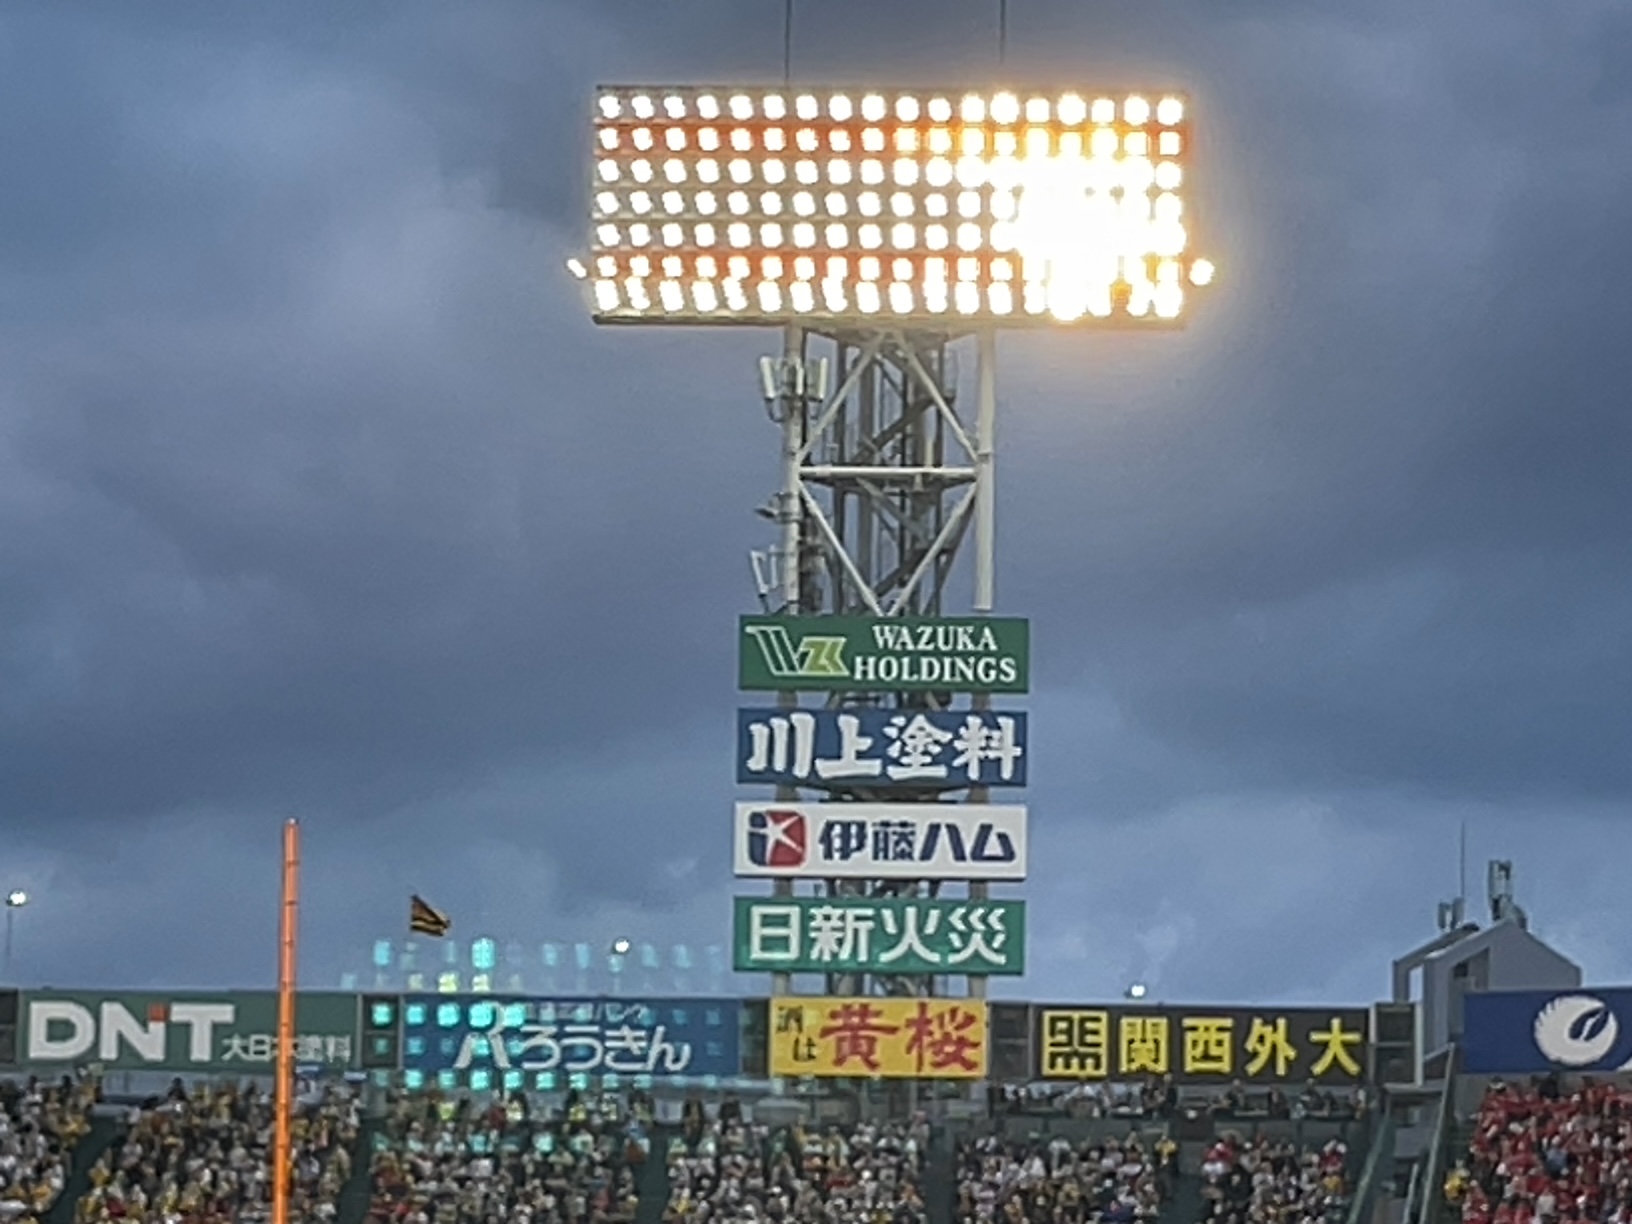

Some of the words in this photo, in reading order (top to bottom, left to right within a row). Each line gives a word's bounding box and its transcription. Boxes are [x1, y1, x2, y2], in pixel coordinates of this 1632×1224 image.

[872, 625, 998, 651] WAZUKA
[854, 655, 1017, 683] HOLDINGS
[746, 712, 1023, 781] 川上塗料
[819, 819, 1016, 862] 伊藤ハム
[750, 905, 1006, 965] 日新火災
[28, 1001, 235, 1062] DNT
[520, 1025, 692, 1072] ろうきん
[819, 1001, 981, 1073] 黄桜
[1118, 1015, 1362, 1077] 関西外大
